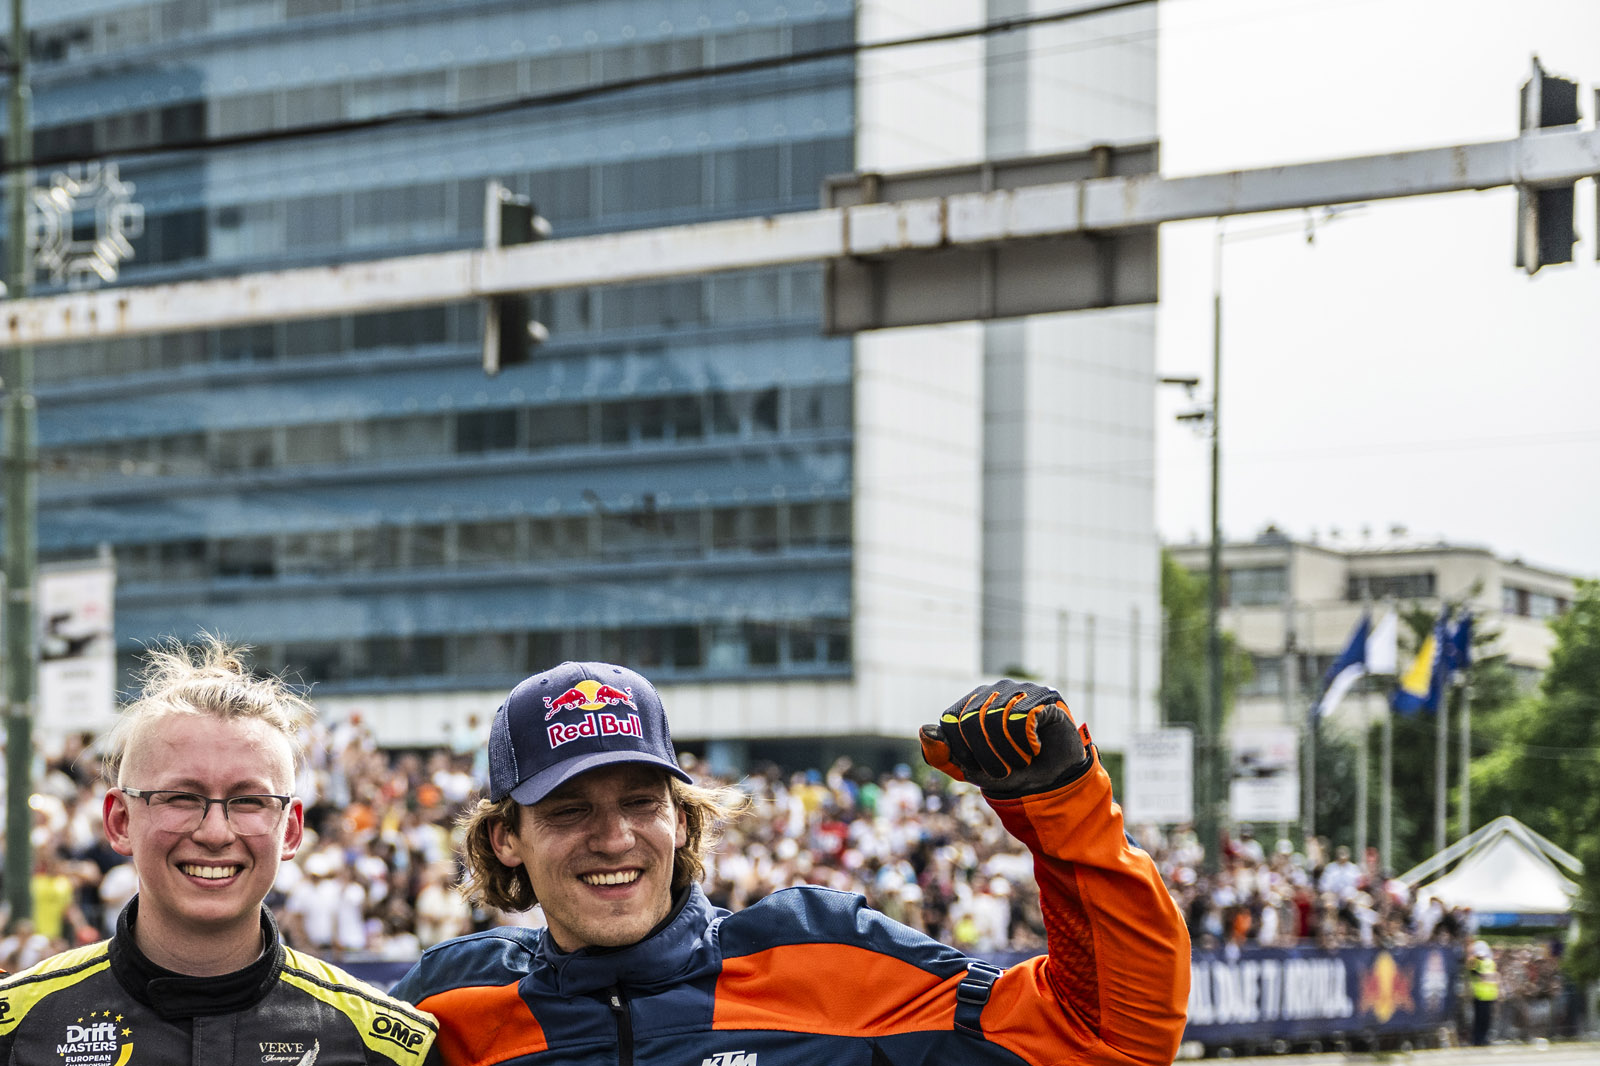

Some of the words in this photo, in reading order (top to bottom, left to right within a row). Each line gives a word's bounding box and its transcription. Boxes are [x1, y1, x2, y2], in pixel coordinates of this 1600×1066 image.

[547, 713, 598, 749] Red
[598, 713, 643, 739] Bull
[66, 1022, 117, 1043] Drift
[372, 1016, 424, 1048] OMP
[56, 1041, 117, 1054] MASTERS
[259, 1042, 305, 1053] VERVE
[65, 1054, 112, 1063] EUROPEAN
